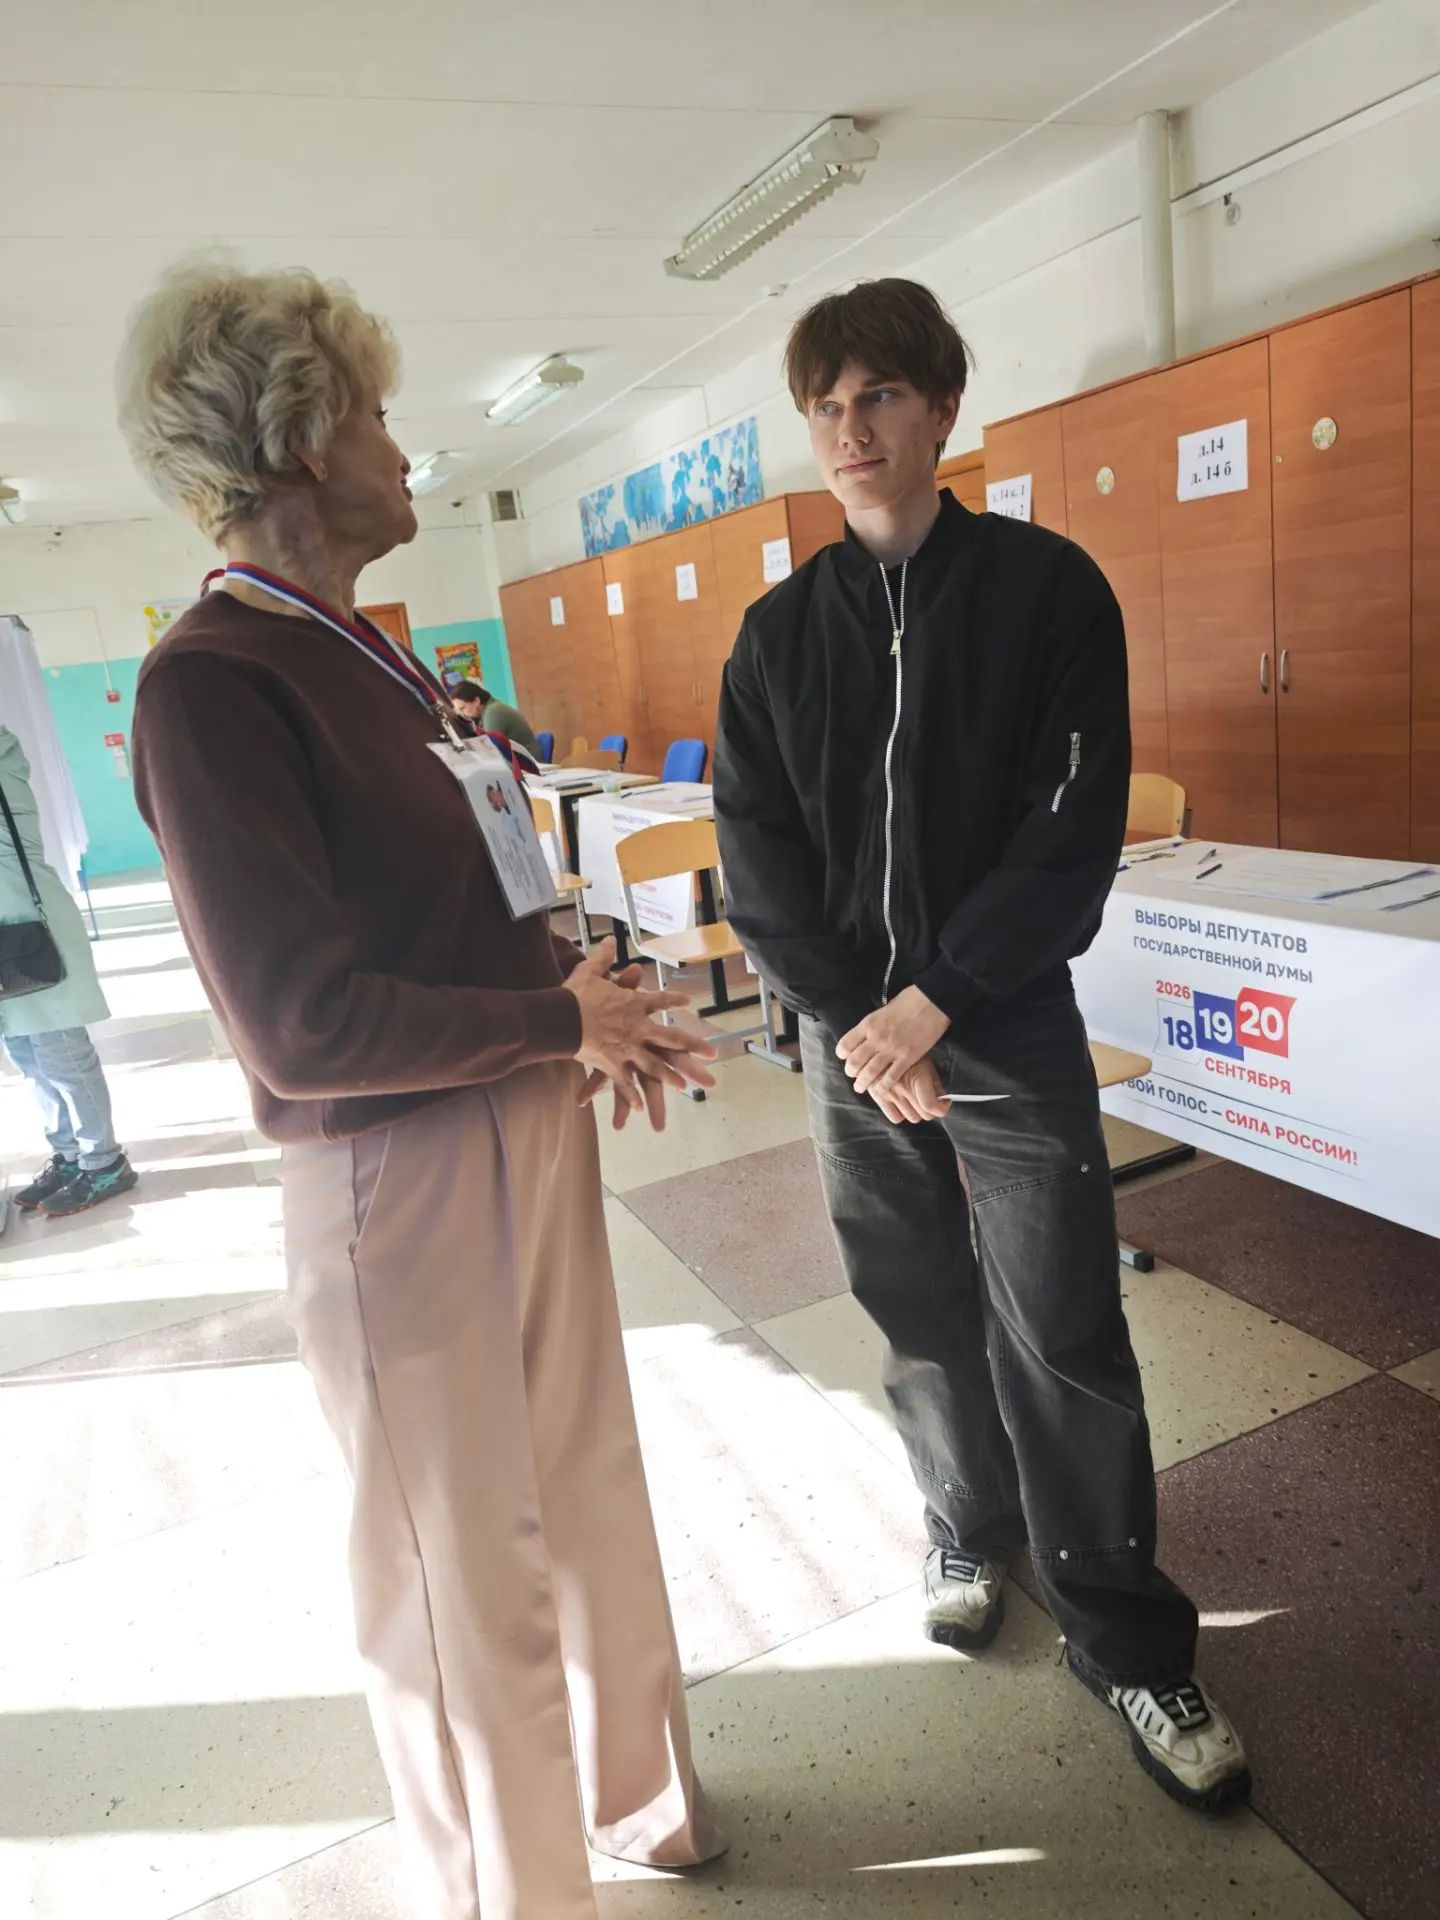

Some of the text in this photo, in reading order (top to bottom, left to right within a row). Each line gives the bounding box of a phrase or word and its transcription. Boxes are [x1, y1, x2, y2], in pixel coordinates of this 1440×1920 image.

[1207, 463, 1220, 480] 14
[1224, 460, 1232, 476] б
[1135, 909, 1308, 953] ВЫБОРЫ ДЕПУТАТОВ
[1134, 936, 1313, 983] ГОСУДАРСТВЕННОЙ ДУМЫ
[1155, 980, 1191, 1000] 2026
[1163, 1001, 1285, 1051] 18 19 20
[1204, 1056, 1292, 1095] СЕНТЯБРЯ
[1158, 1086, 1208, 1114] ГОЛОС
[1225, 1109, 1271, 1136] СИЛА
[1275, 1125, 1359, 1166] РОССИИ!
